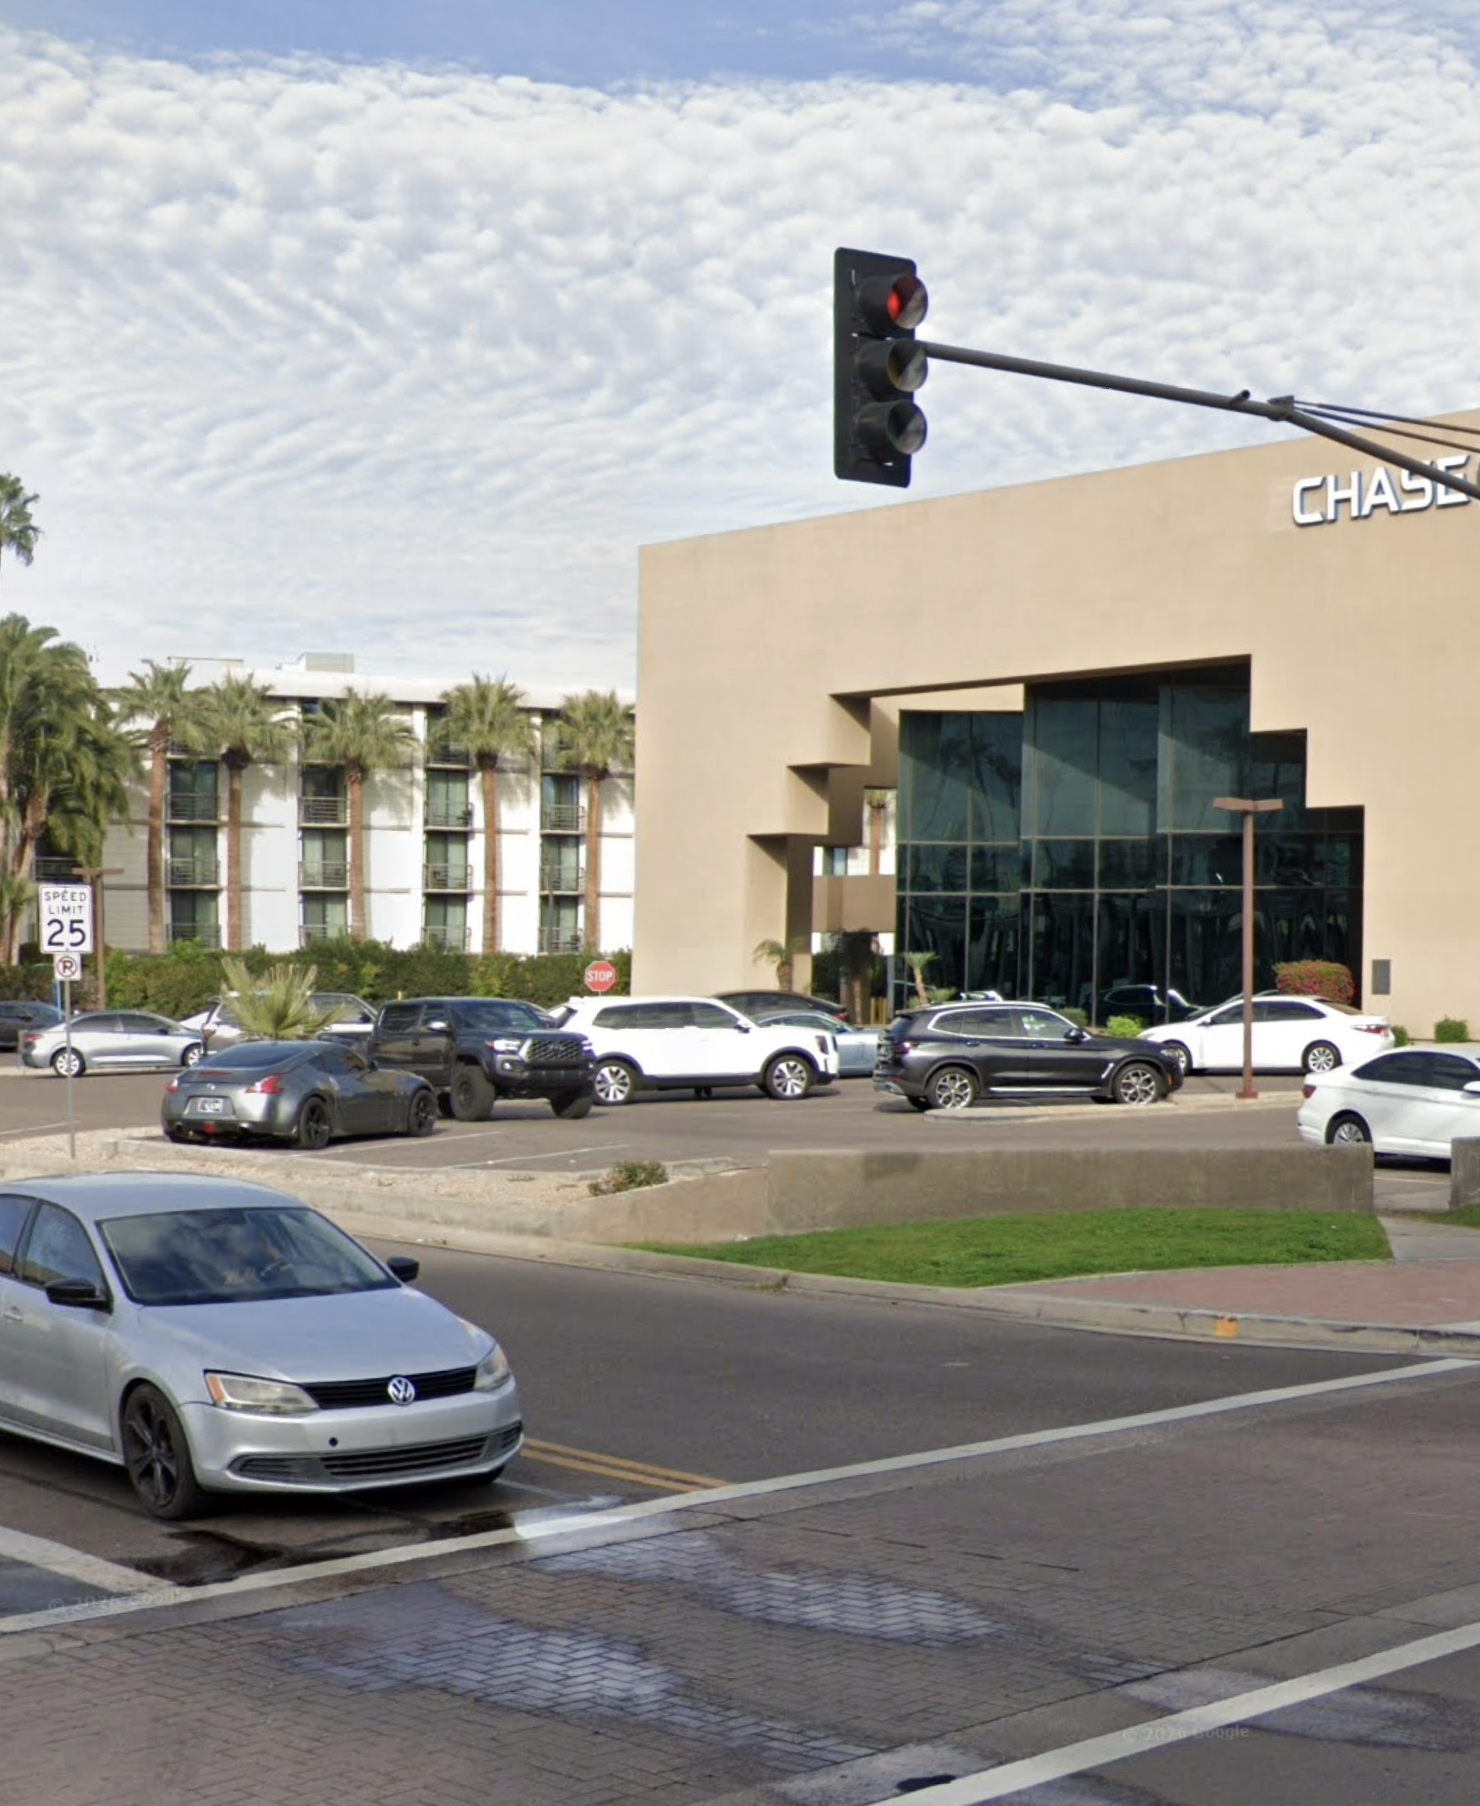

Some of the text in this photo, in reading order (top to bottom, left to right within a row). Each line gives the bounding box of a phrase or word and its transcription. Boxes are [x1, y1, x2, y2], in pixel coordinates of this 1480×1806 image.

[1293, 455, 1470, 527] CHASE
[44, 891, 87, 902] SPEED
[48, 905, 84, 915] LIMIT
[47, 918, 86, 947] 25
[587, 970, 613, 982] STOP
